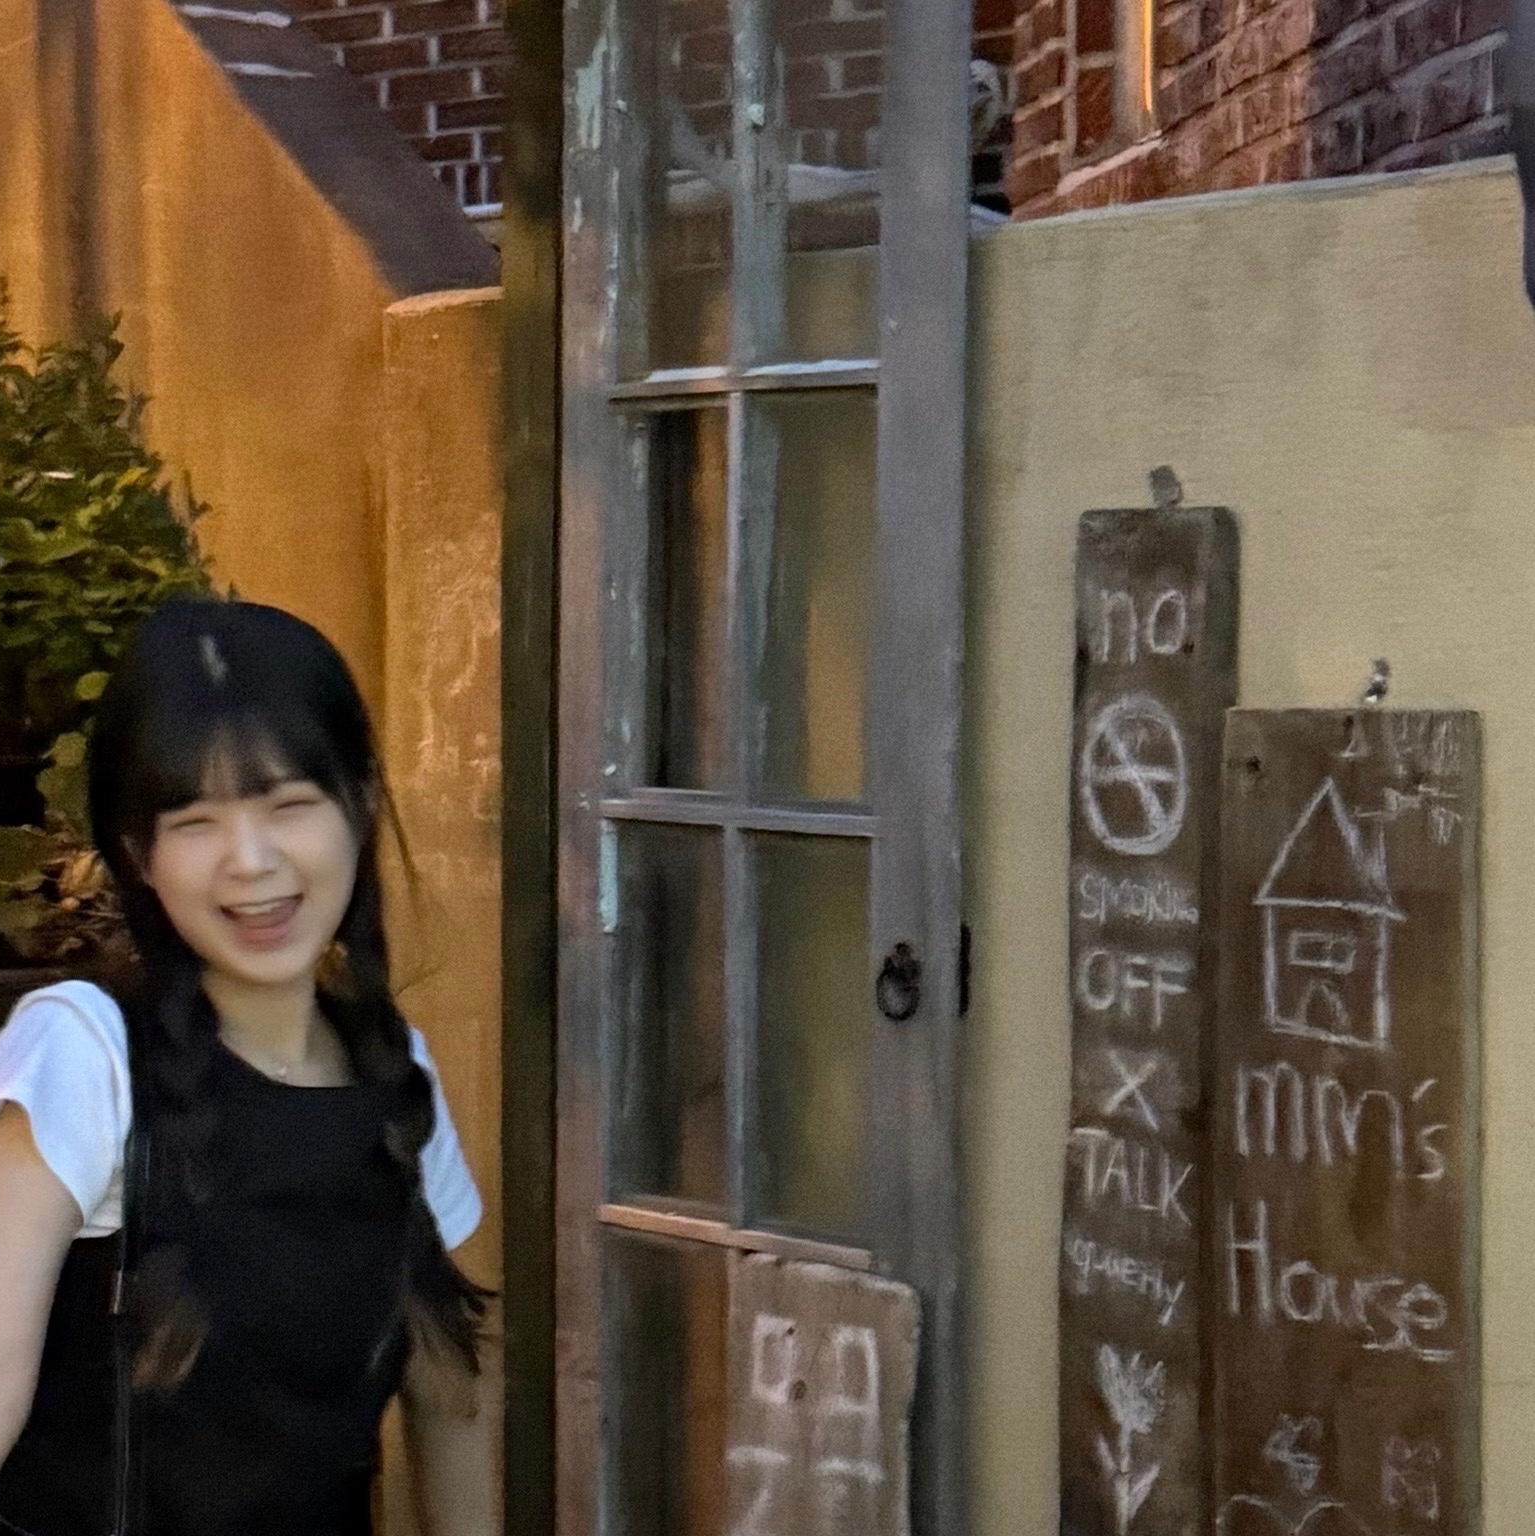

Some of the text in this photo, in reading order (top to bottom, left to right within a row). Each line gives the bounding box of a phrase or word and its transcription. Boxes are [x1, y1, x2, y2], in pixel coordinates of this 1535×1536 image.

[1100, 588, 1186, 664] no
[1078, 947, 1191, 1033] OFF
[1072, 1127, 1195, 1226] TALK
